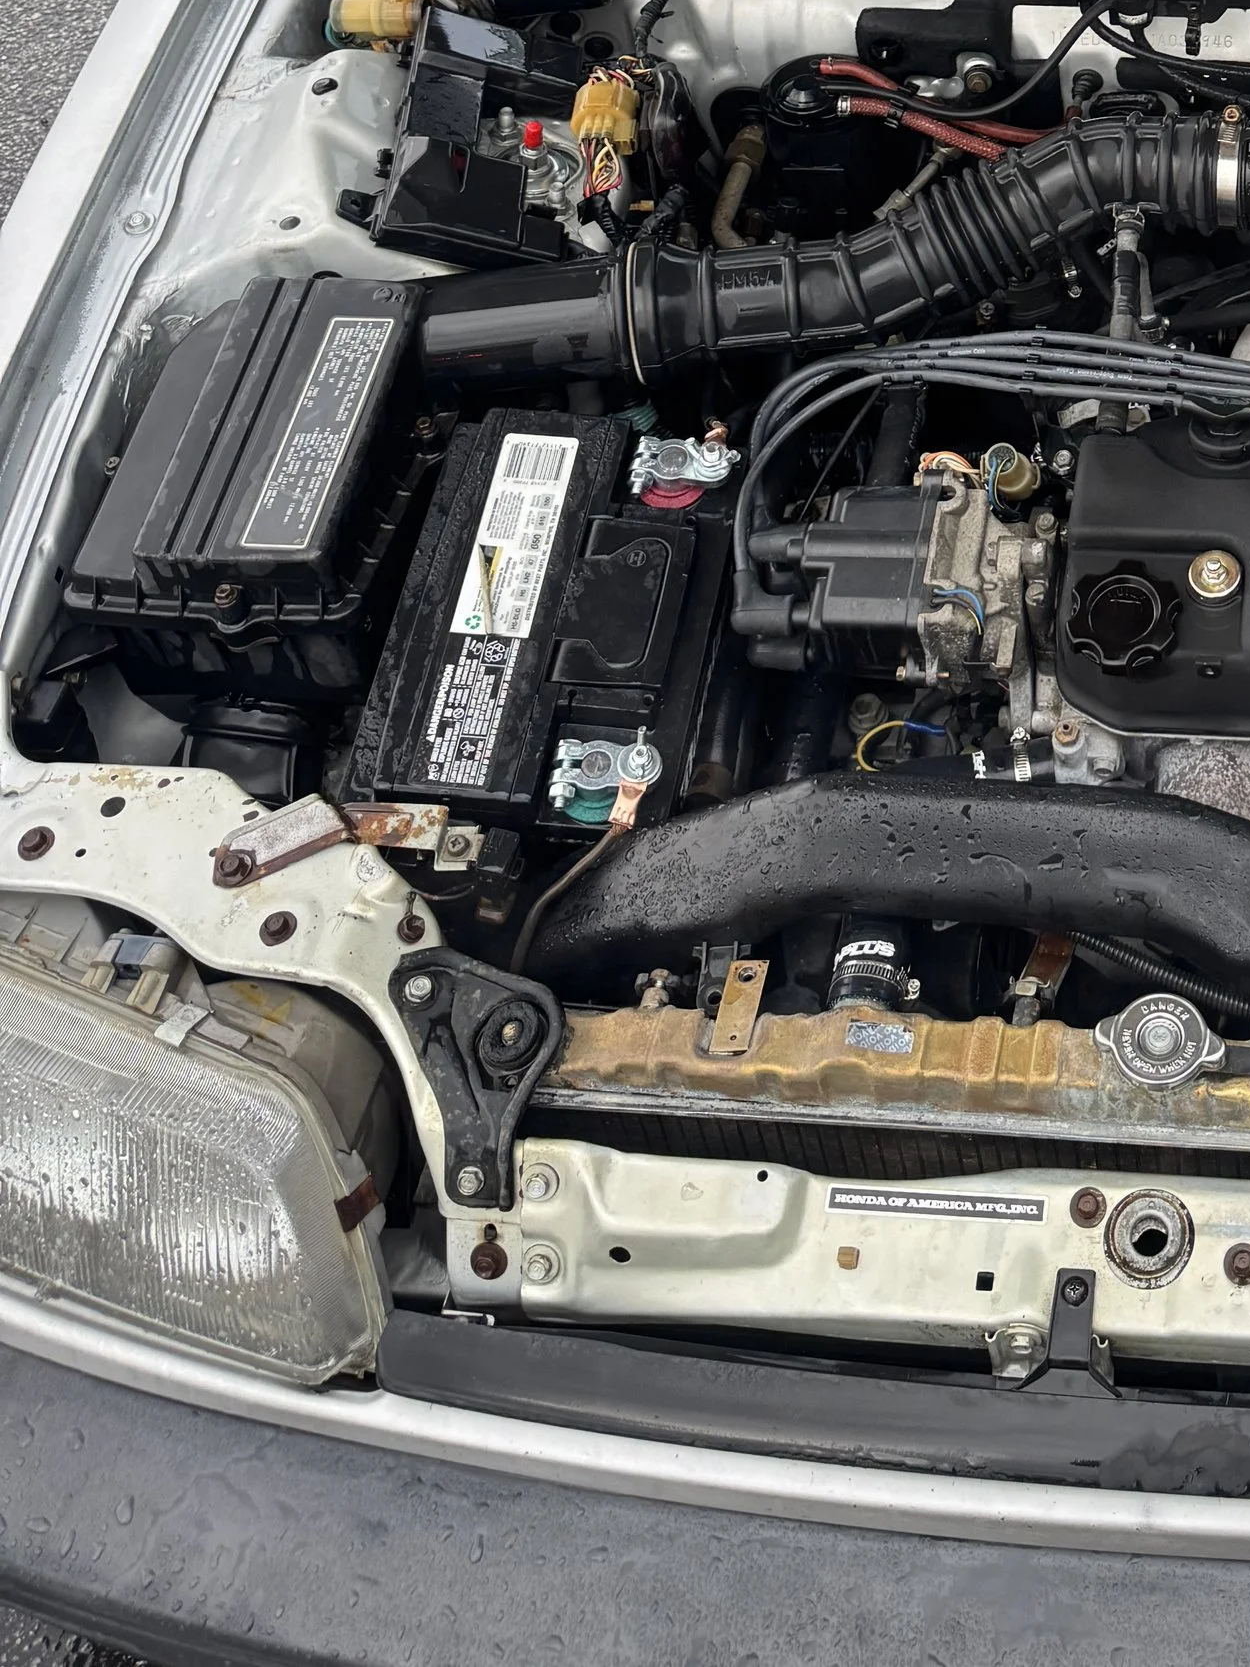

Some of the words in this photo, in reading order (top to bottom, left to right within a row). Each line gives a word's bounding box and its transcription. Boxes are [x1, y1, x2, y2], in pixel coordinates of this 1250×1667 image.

[431, 664, 456, 736] DANGER/POISON
[1140, 1001, 1191, 1022] DANGER
[1121, 1028, 1136, 1061] NEVER
[1132, 1058, 1157, 1074] OPEN
[1158, 1057, 1187, 1074] WHEN
[1184, 1040, 1197, 1060] HOT
[834, 1193, 887, 1206] HONDA
[888, 1197, 907, 1207] OF
[907, 1198, 974, 1211] AMERICA
